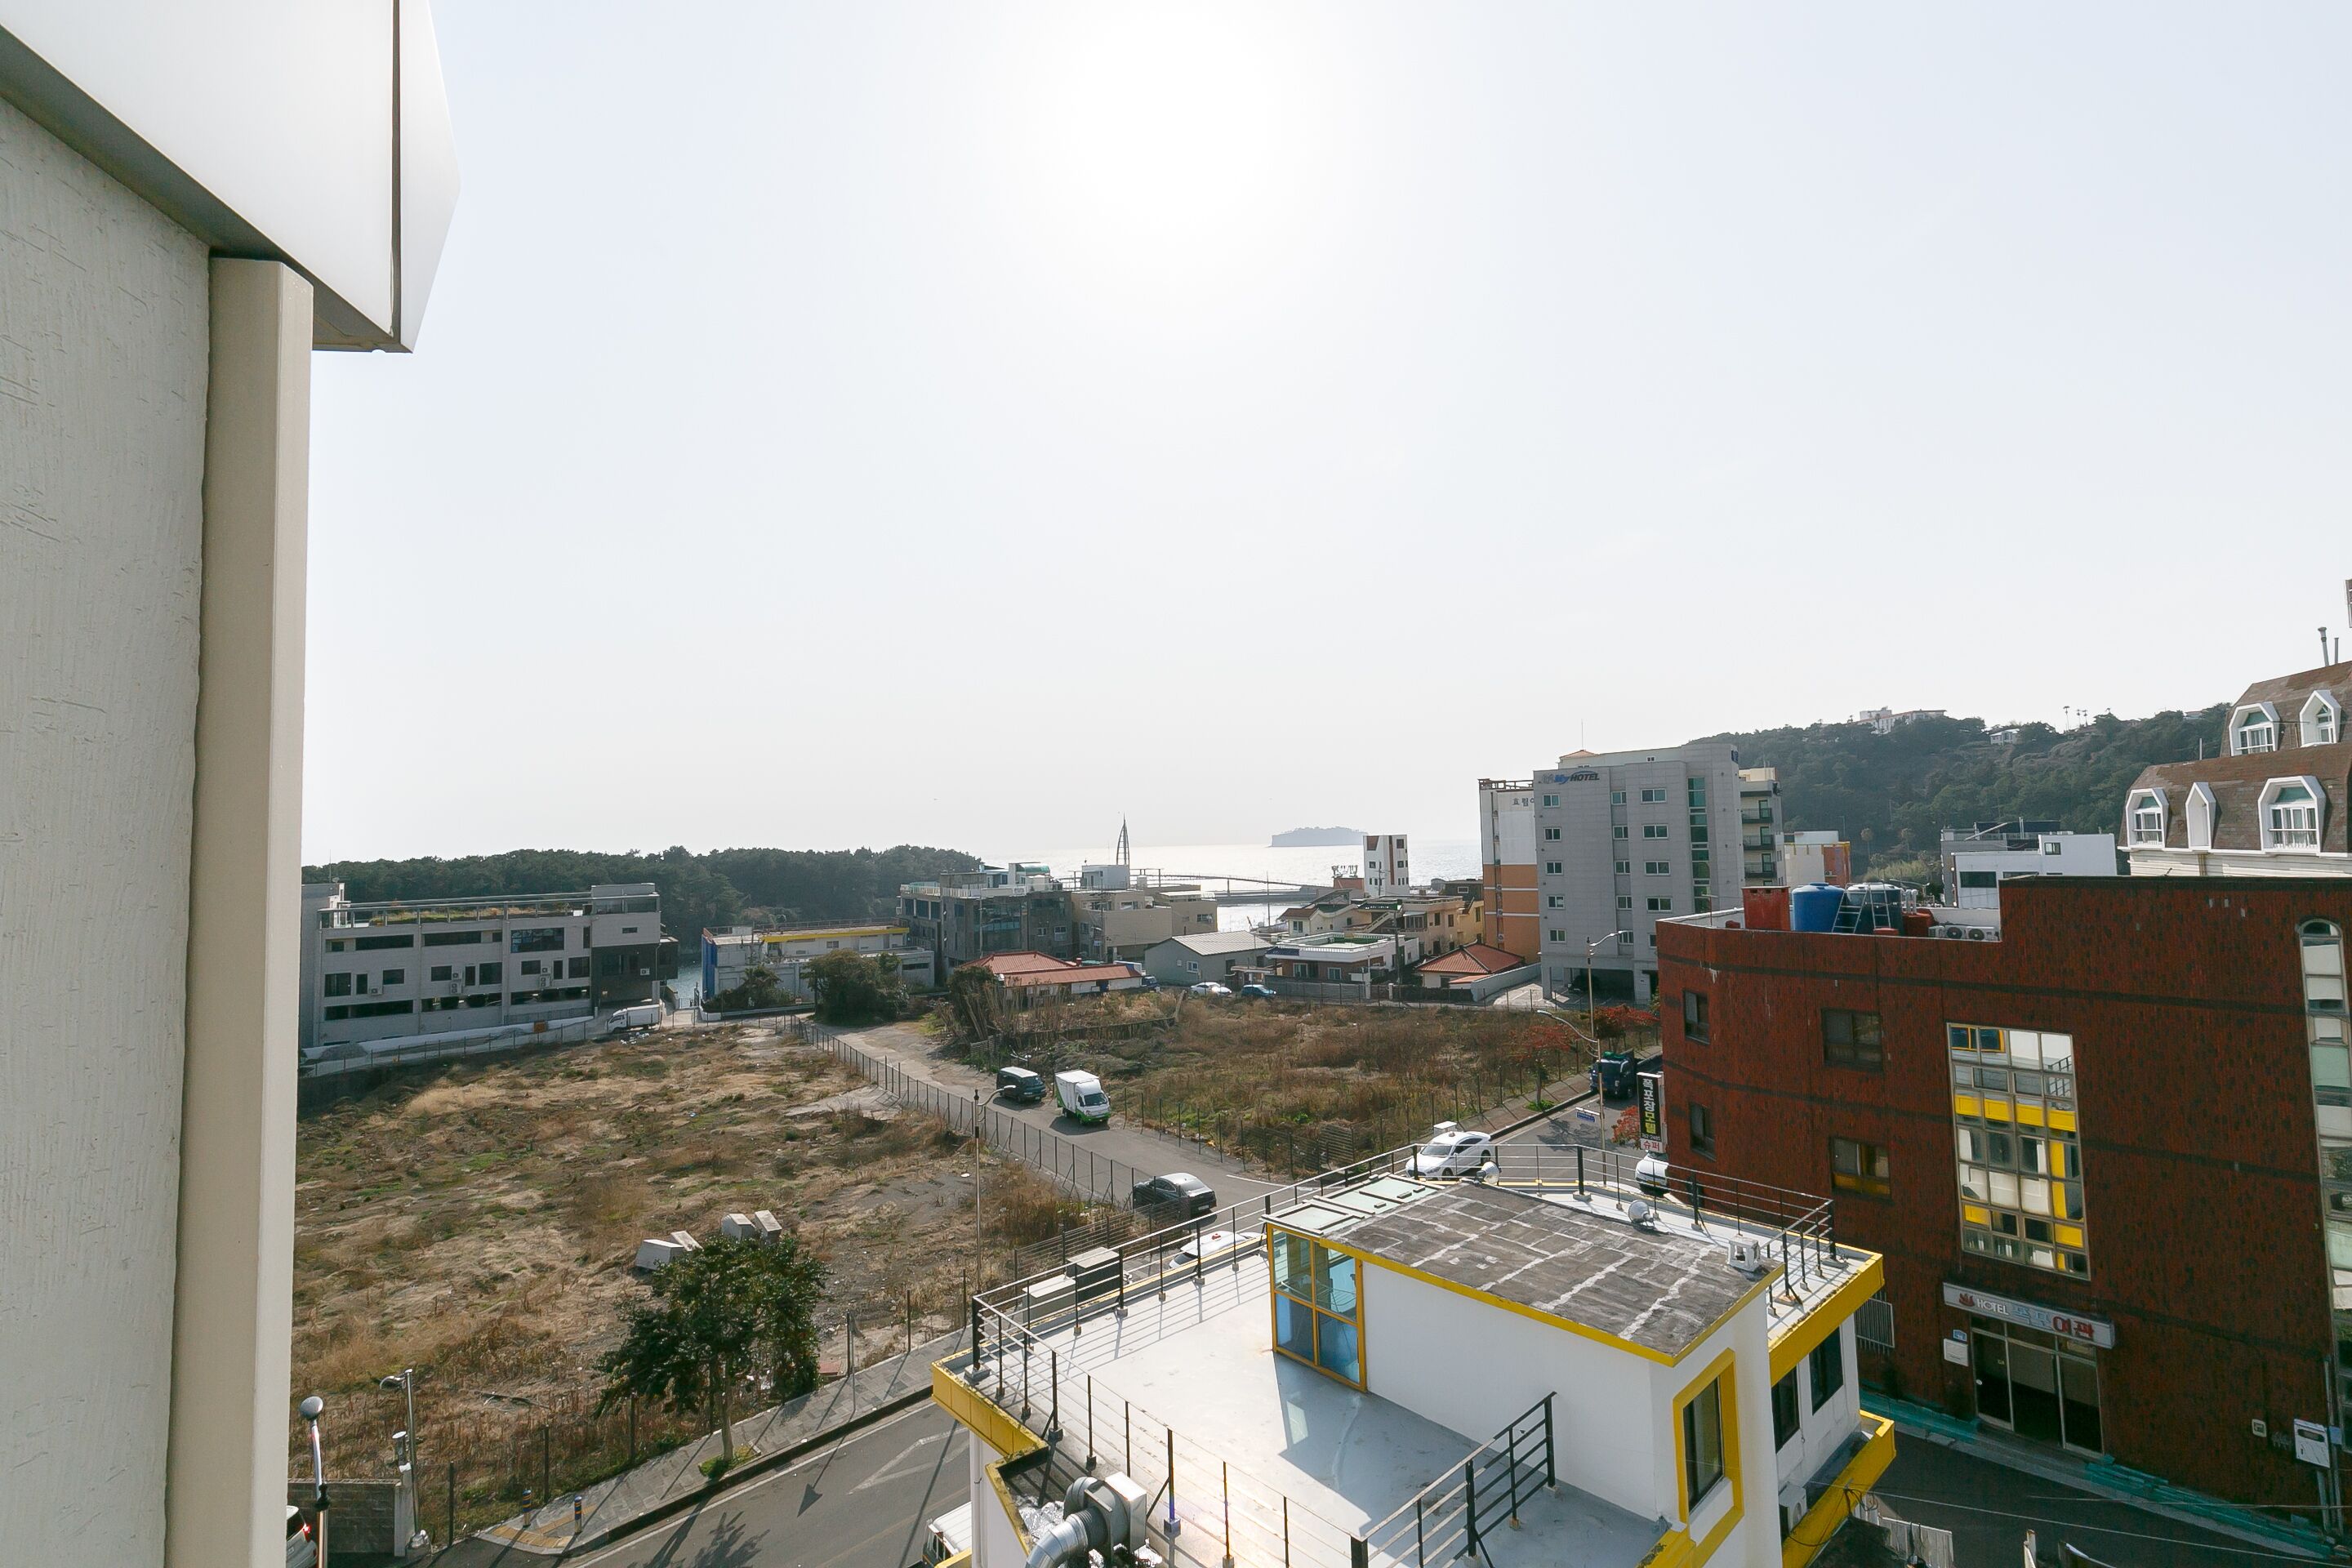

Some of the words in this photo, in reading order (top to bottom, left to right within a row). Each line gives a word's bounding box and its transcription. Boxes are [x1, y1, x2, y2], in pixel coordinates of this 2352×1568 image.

[1570, 773, 1600, 782] HOTEL
[1643, 1140, 1659, 1152] 슈퍼
[1976, 1298, 2009, 1316] HOTEL
